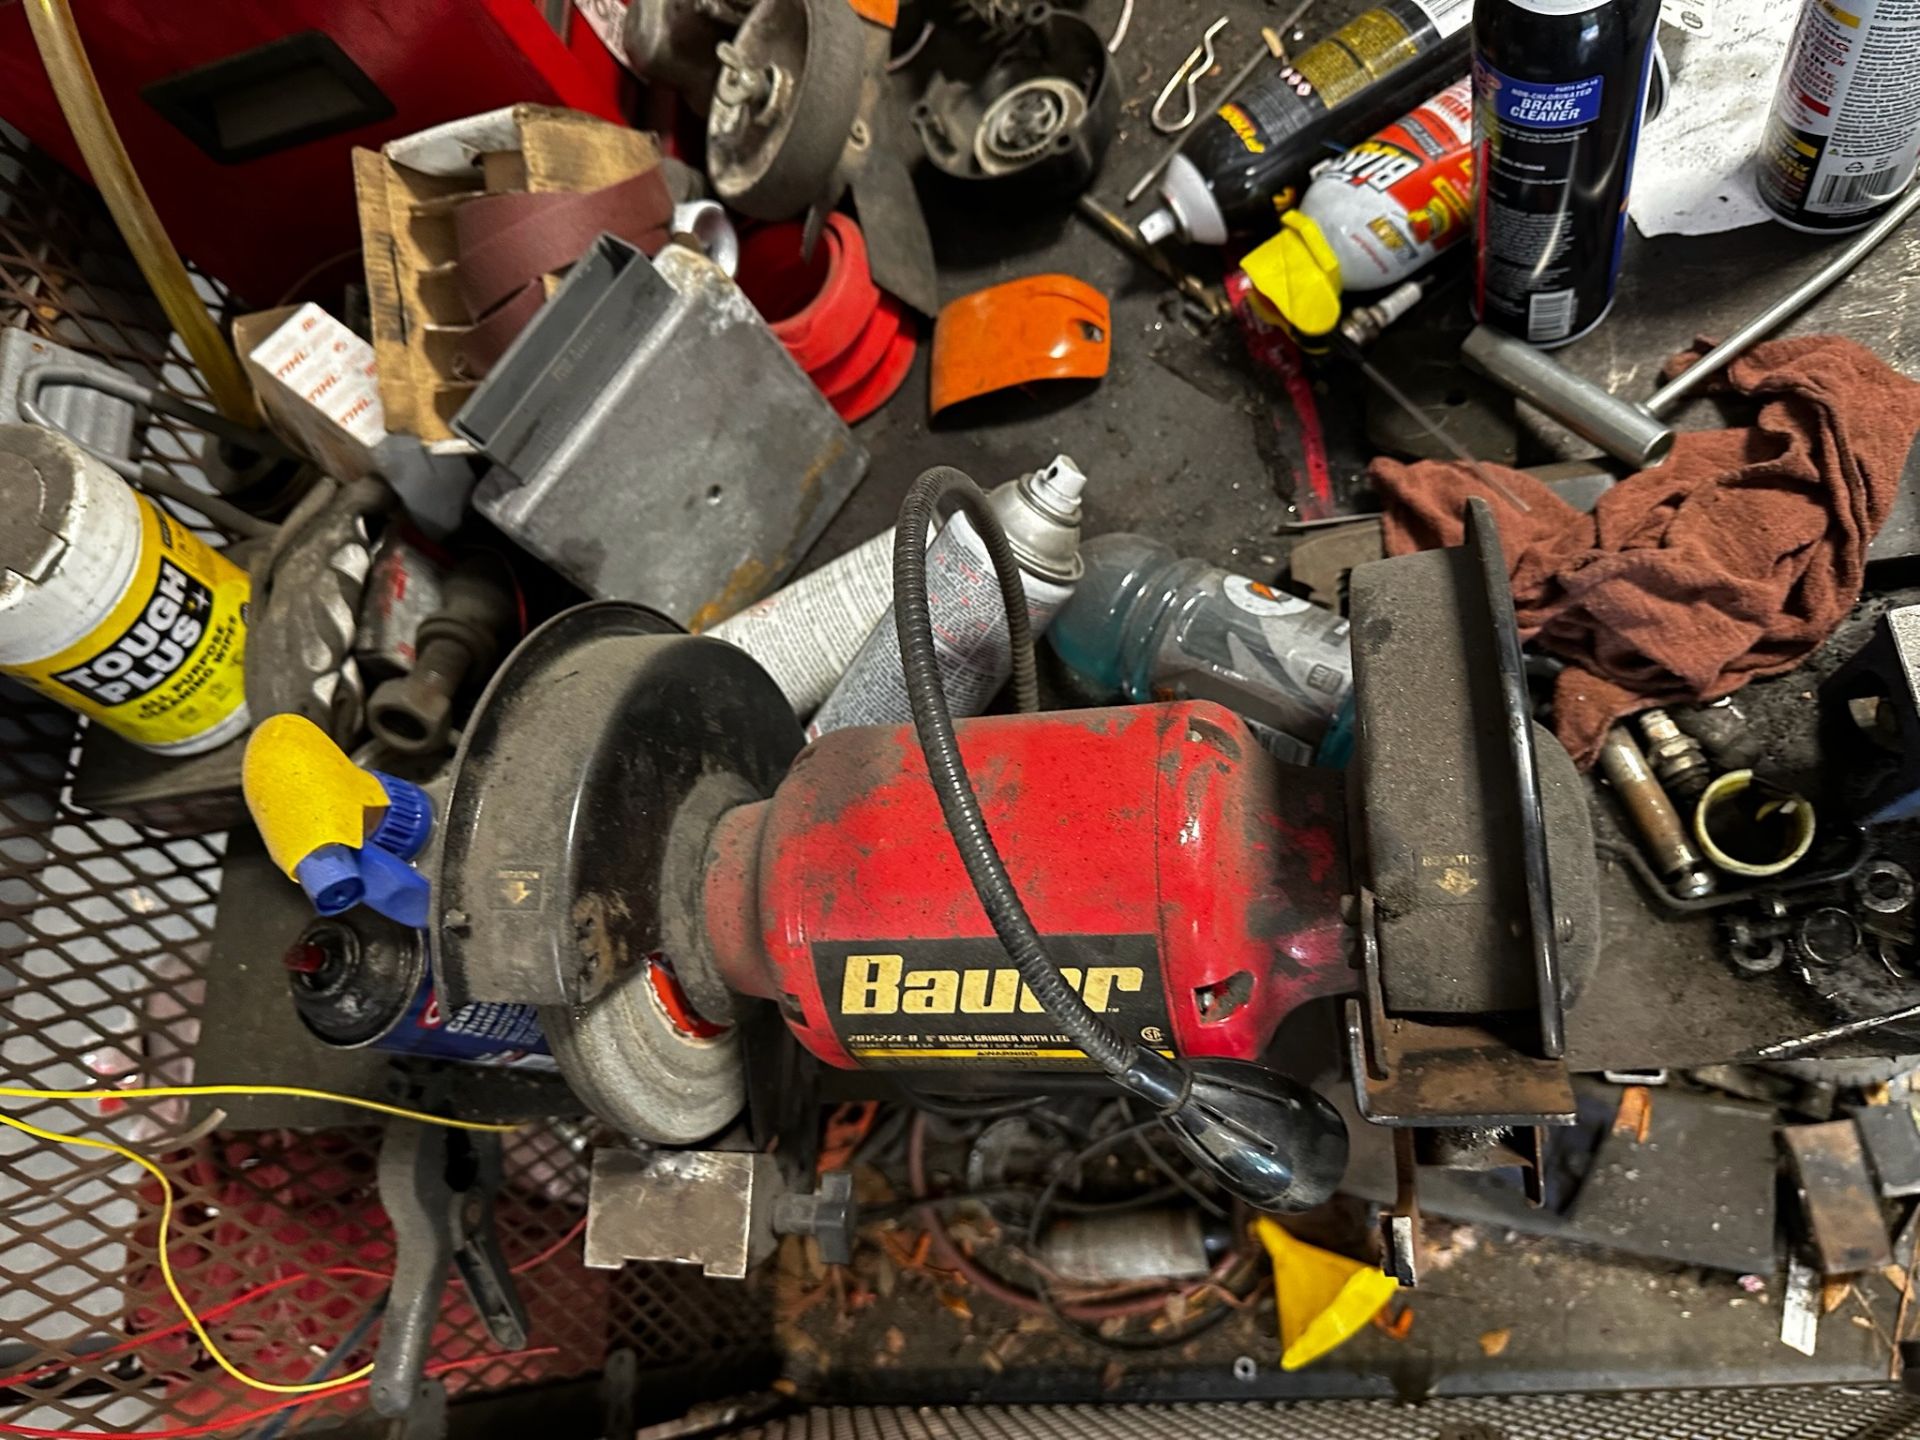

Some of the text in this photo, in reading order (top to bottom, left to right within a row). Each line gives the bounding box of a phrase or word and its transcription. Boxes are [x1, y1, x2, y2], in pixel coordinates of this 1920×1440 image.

[1510, 106, 1581, 122] CLEANER
[1520, 98, 1576, 111] BRAKE
[275, 347, 309, 380] TIHL
[307, 374, 341, 403] TIHL
[338, 397, 373, 426] TIHL
[57, 562, 187, 688] TOUGH
[94, 615, 201, 704] PLUS
[172, 625, 225, 693] PURPOSE
[138, 667, 214, 720] CLEANING
[938, 1034, 973, 1042] BENCH
[973, 1034, 1020, 1043] GRINDER
[1019, 1034, 1049, 1042] WITH
